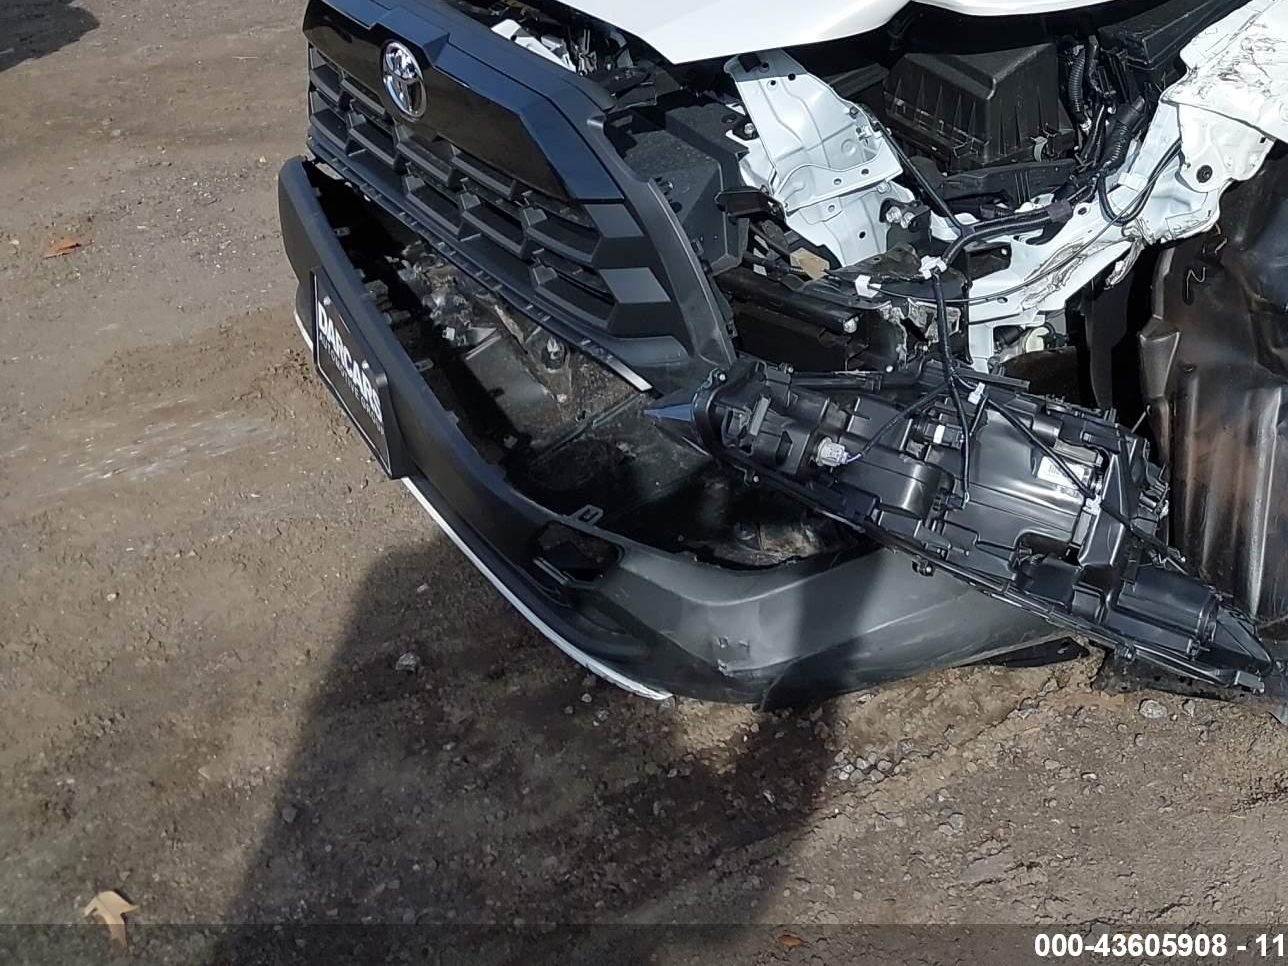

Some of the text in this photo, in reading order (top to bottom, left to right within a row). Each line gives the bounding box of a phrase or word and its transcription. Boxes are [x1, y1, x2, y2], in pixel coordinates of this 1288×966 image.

[318, 301, 383, 423] DARCARS
[318, 330, 385, 435] AUTOMOTIVE GROUP
